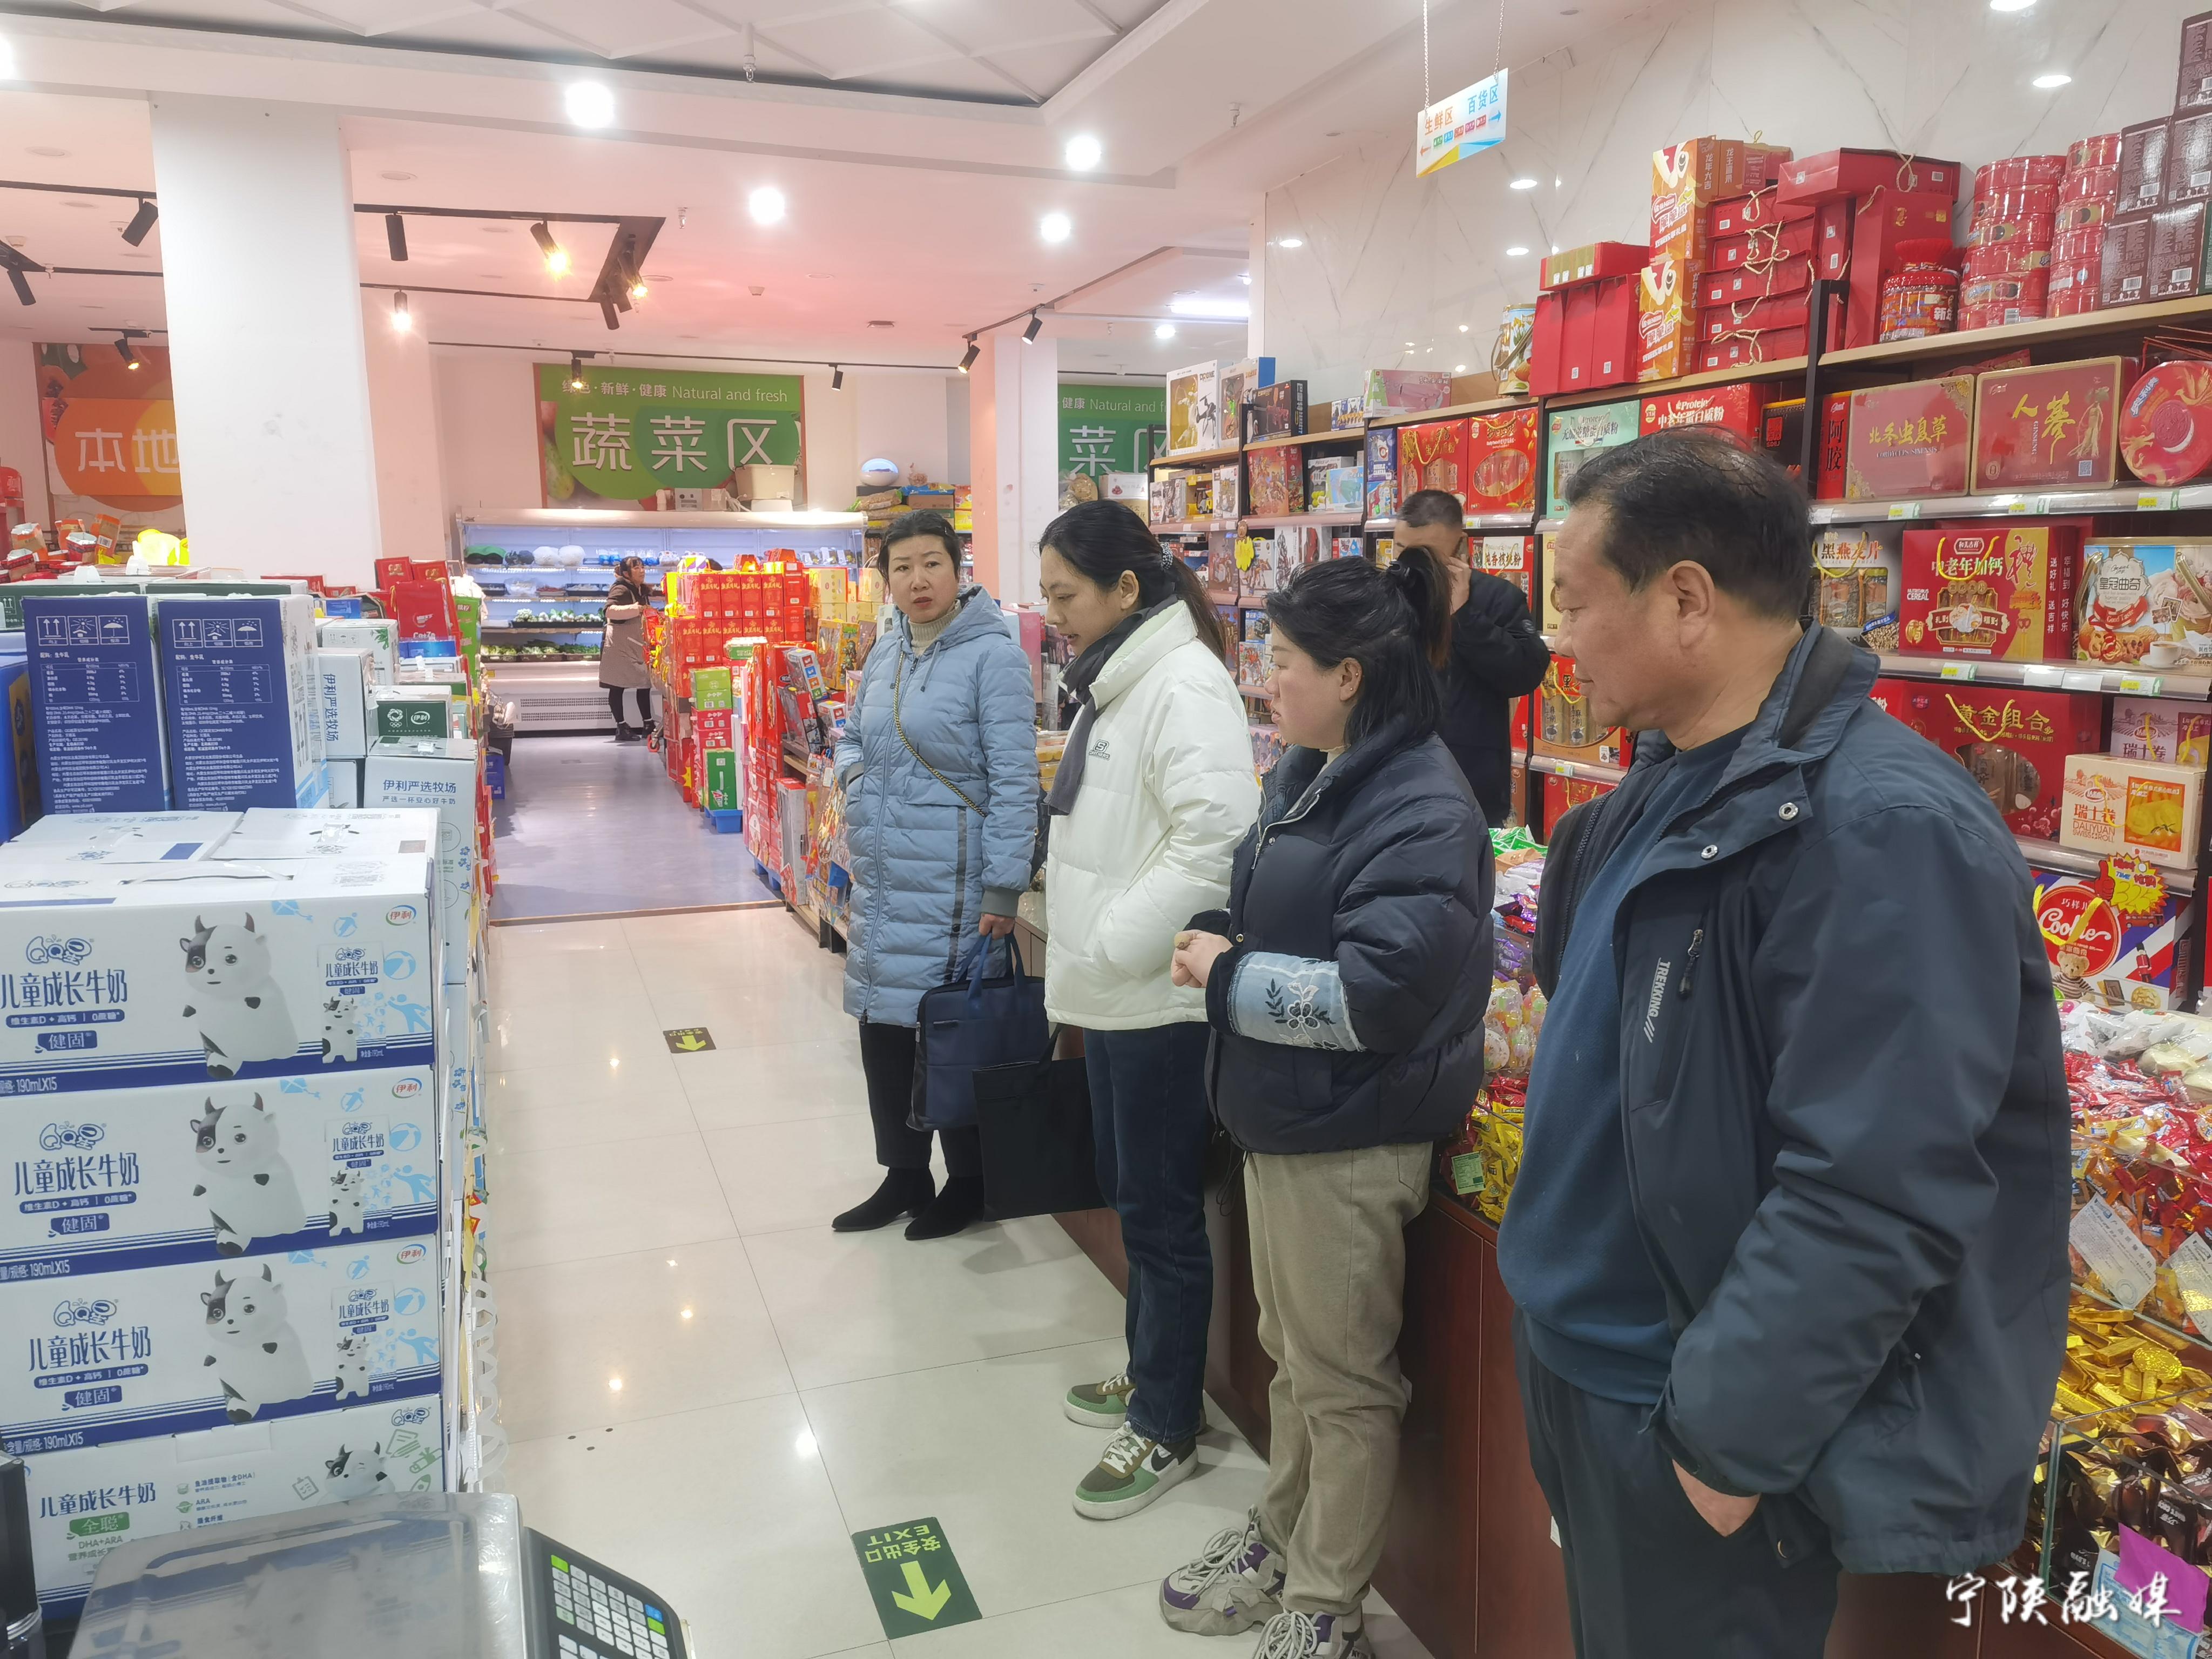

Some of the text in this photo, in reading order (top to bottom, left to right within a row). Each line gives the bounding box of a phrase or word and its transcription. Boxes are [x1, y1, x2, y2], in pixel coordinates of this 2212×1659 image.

[1467, 84, 1499, 114] 百货区
[1425, 106, 1453, 136] 生鲜区
[673, 386, 721, 400] Natural
[726, 387, 751, 401] and
[756, 388, 788, 403] fresh
[1062, 397, 1085, 409] 健康
[1090, 399, 1131, 411] Natural
[1135, 401, 1156, 413] and
[75, 428, 180, 473] 本地
[571, 412, 778, 472] 蔬菜区
[1825, 419, 1844, 471] 阿胶
[2100, 577, 2141, 591] 皇冠曲奇
[2047, 557, 2058, 633] 送好礼 送吉祥
[322, 673, 339, 742] 伊利严选牧场
[1959, 703, 2051, 731] 黄金组合
[383, 779, 456, 793] 伊利严选牧场
[382, 795, 456, 805] 严选一杯安心好牛奶
[2074, 804, 2116, 824] 瑞士卷
[2098, 834, 2115, 842] ROLL
[2116, 871, 2131, 880] TIME
[390, 911, 412, 920] 伊利
[326, 960, 378, 977] 儿童成长牛奶
[0, 968, 128, 1009] 儿童成长牛奶
[1649, 961, 1671, 1017] TREKKING
[49, 1032, 85, 1049] 健固
[16, 1077, 57, 1092] 190mLX15
[396, 1083, 417, 1094] 伊利
[333, 1133, 385, 1152] 儿童成长牛奶
[15, 1152, 139, 1196] 儿童成长牛奶
[61, 1215, 97, 1233] 健固
[401, 1249, 422, 1259] 伊利
[30, 1259, 70, 1277] 190mLX15
[339, 1299, 389, 1319] 儿童成长牛奶
[29, 1326, 151, 1372] 儿童成长牛奶
[75, 1388, 110, 1406] 健固
[43, 1432, 84, 1449] 190mLX15
[39, 1482, 156, 1519] 儿童成长牛奶
[82, 1515, 119, 1534] 全聪
[78, 1535, 123, 1549] DHA+ARA
[867, 1525, 930, 1546] EXIT
[865, 1535, 941, 1563] 安全出口
